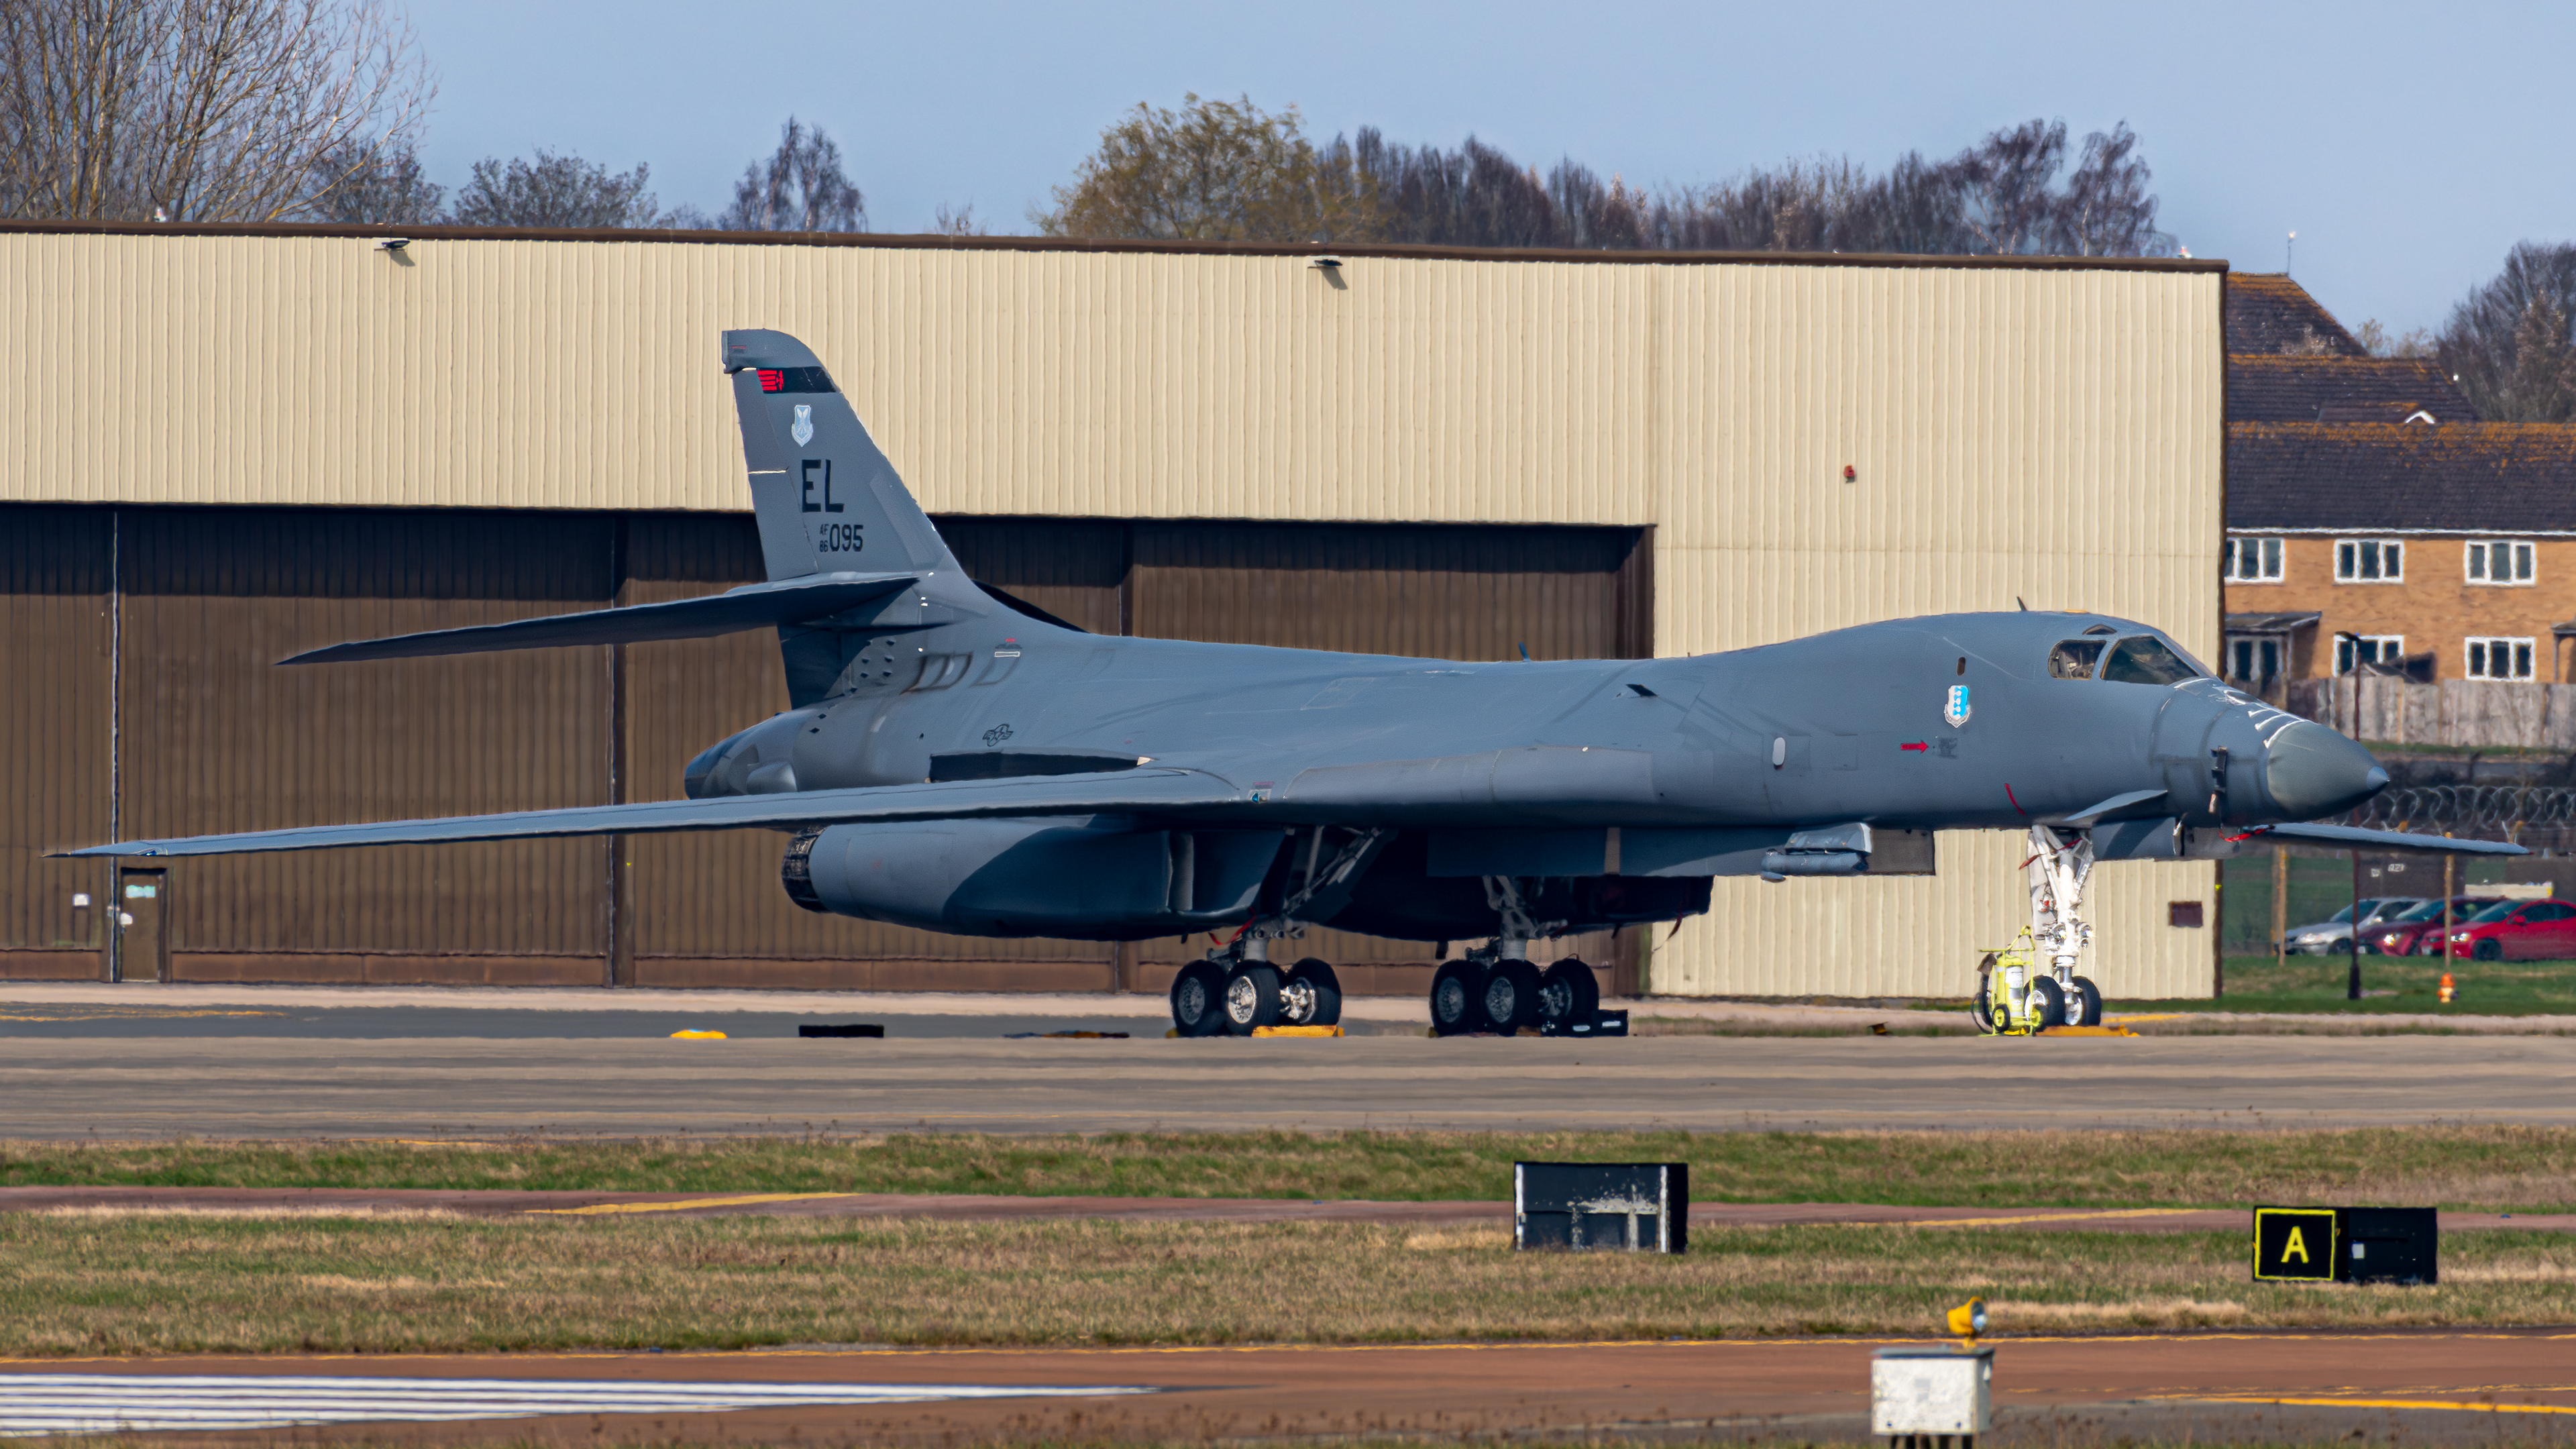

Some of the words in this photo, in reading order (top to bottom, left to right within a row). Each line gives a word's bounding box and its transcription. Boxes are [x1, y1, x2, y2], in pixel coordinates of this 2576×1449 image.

[802, 459, 845, 513] EL
[819, 539, 828, 552] 86
[829, 523, 864, 552] 095
[2281, 1226, 2309, 1263] A
